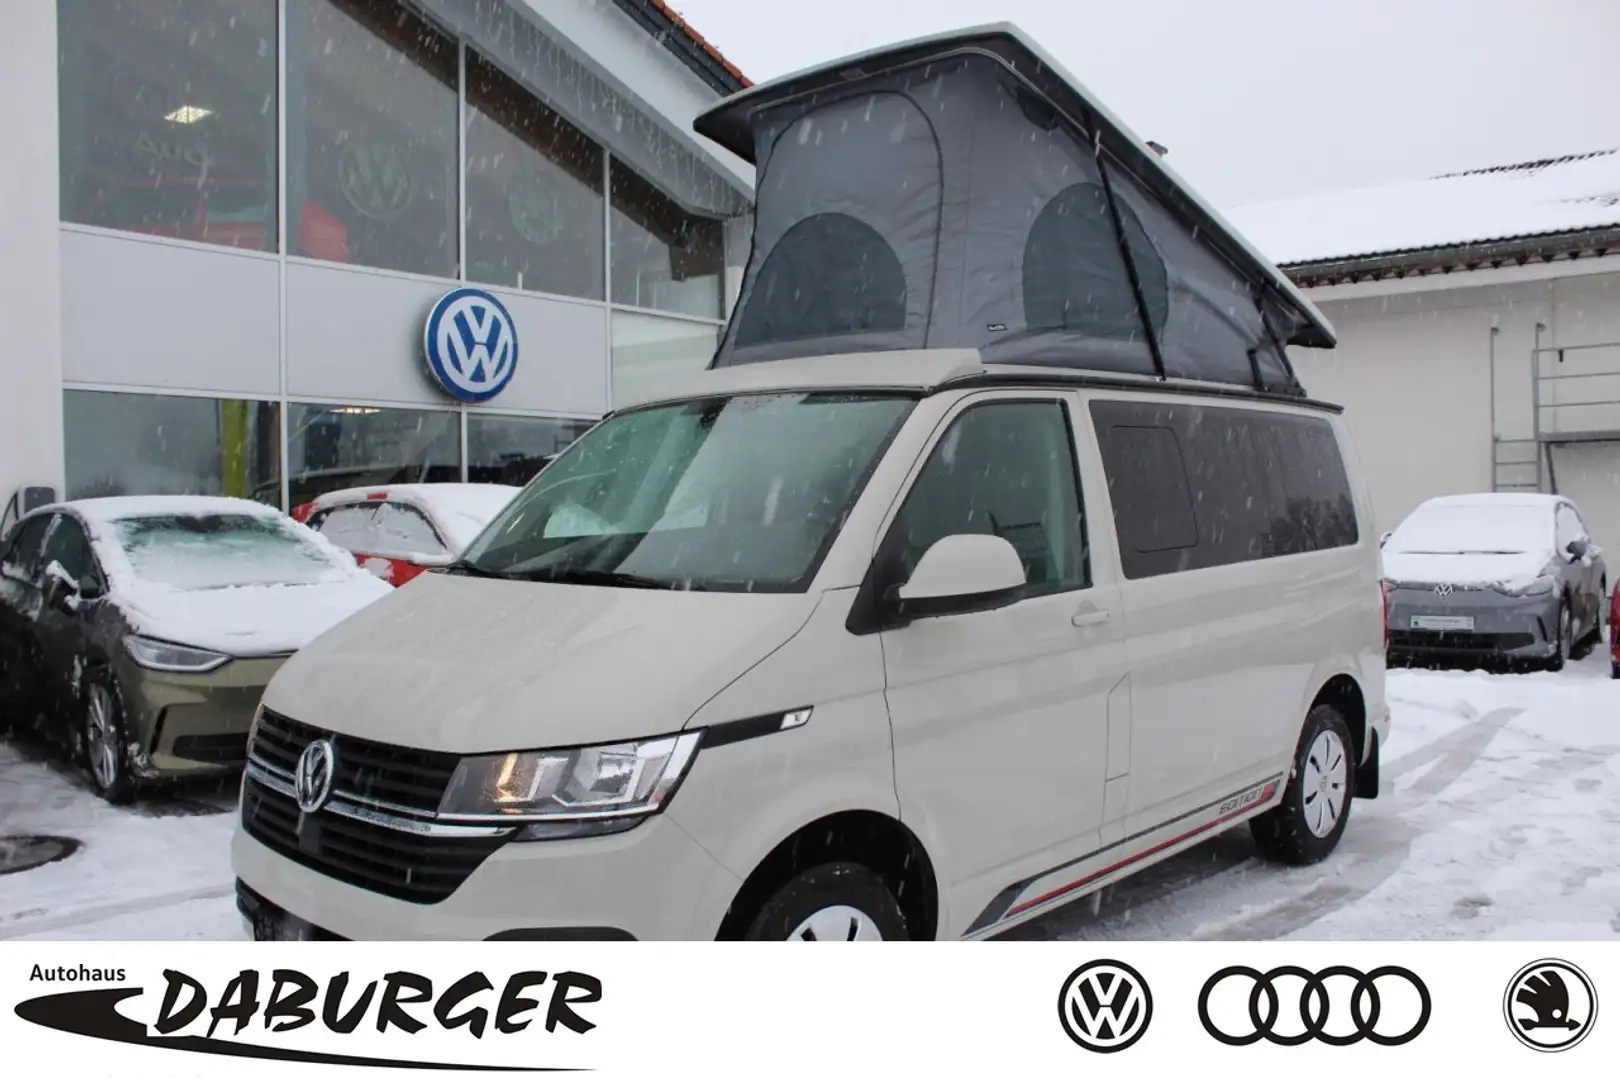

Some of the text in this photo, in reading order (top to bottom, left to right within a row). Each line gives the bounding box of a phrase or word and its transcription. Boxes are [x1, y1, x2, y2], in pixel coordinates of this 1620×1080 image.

[430, 290, 515, 397] VW
[1434, 583, 1453, 599] VW
[297, 741, 332, 810] VW
